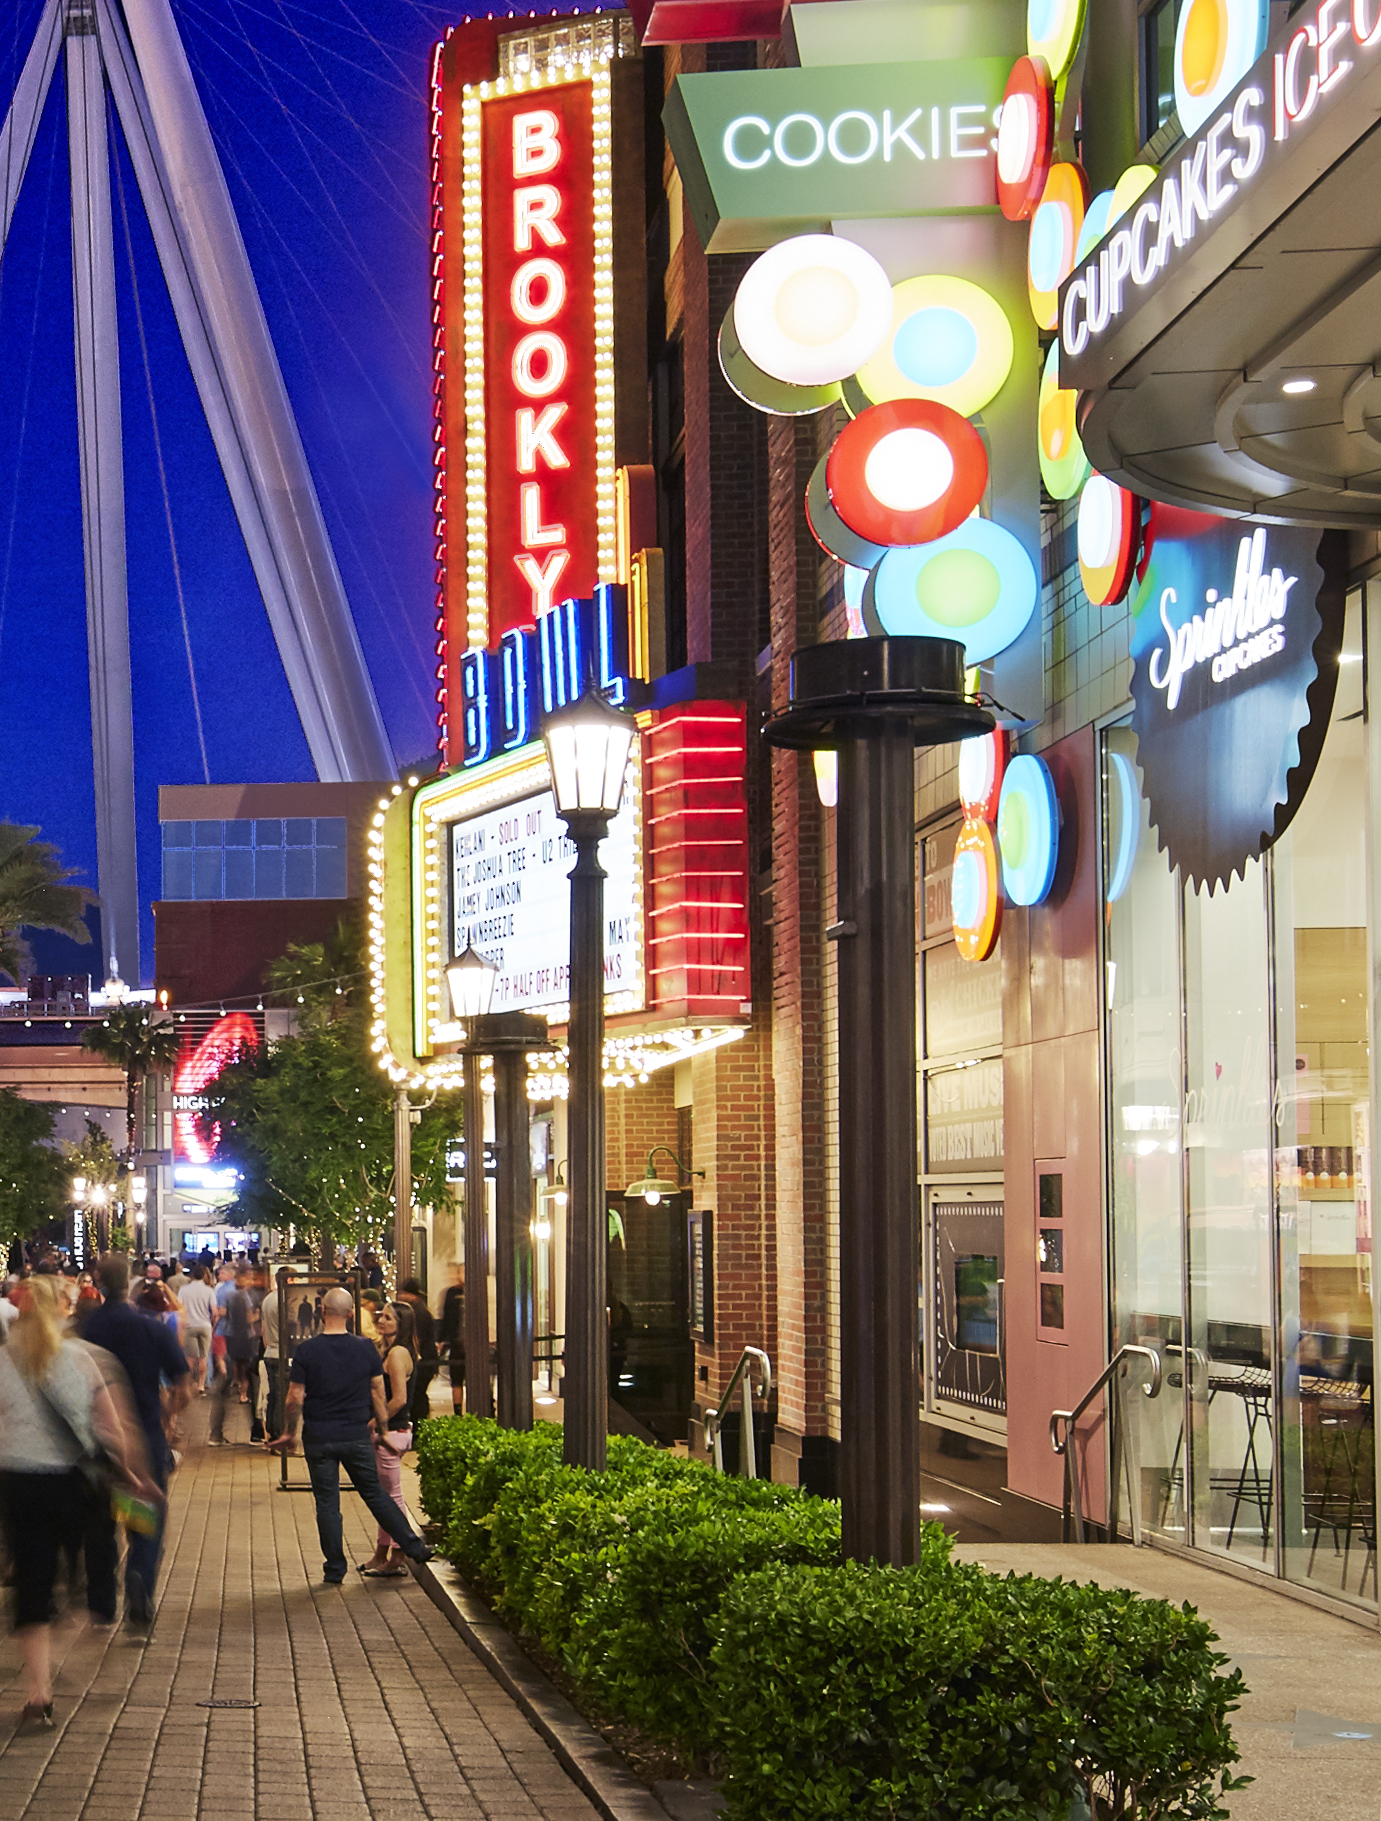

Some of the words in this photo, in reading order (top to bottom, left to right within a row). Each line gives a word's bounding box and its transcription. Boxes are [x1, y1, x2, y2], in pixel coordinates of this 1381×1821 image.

[1062, 86, 1267, 356] CUPCAKES
[510, 109, 571, 627] BROOKLY
[1149, 527, 1299, 711] Sprinkles
[460, 582, 625, 767] BOWL
[1211, 624, 1286, 683] CUPCAKES
[499, 818, 519, 845] SOLD
[526, 810, 542, 836] OUT
[457, 865, 470, 889] THE
[473, 854, 503, 884] JOSHUA
[507, 847, 526, 874] TREE
[542, 838, 553, 864] U2
[558, 835, 579, 860] TRI
[457, 891, 481, 918] JAMEY
[485, 880, 522, 911] JOHNSON
[609, 916, 631, 946] MAY
[513, 972, 533, 998] HALF
[536, 968, 550, 994] OFF
[553, 964, 570, 990] APP
[173, 1095, 209, 1110] HIGH
